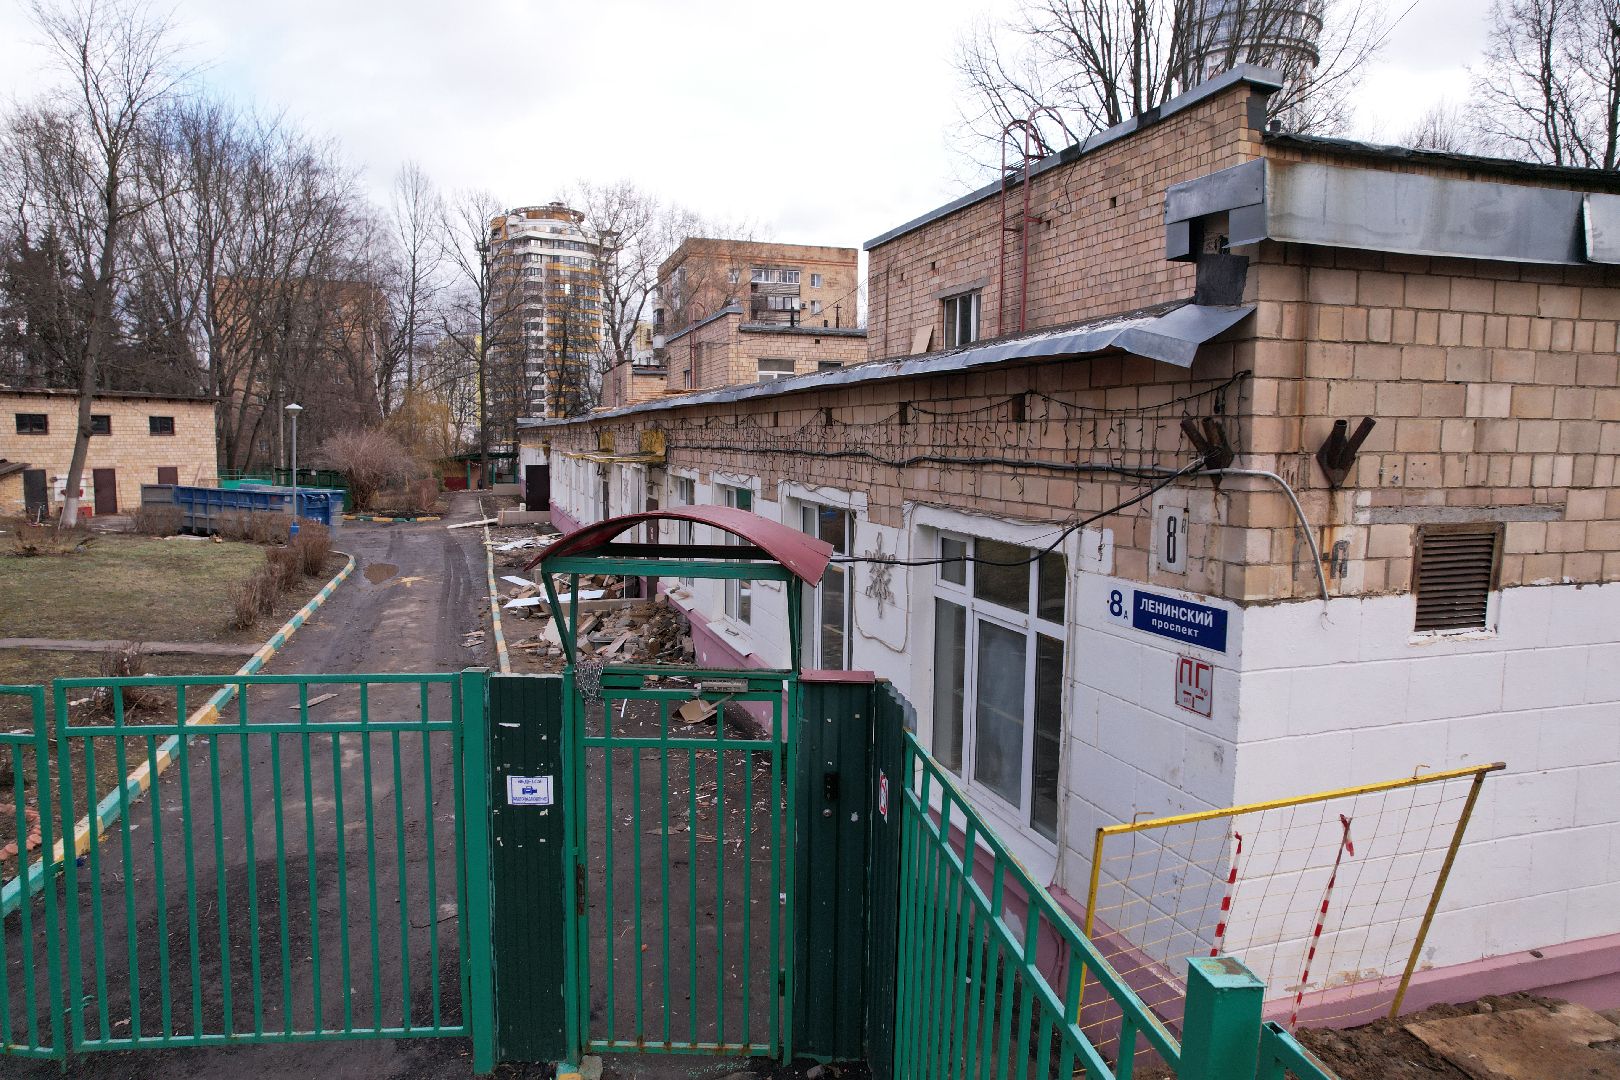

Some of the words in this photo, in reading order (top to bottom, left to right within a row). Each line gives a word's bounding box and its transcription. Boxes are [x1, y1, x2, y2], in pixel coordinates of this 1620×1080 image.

[1167, 516, 1177, 564] 8
[1139, 598, 1213, 628] ЛЕНИНСКИЙ
[1151, 618, 1199, 638] проспект
[1180, 659, 1210, 688] ПГ
